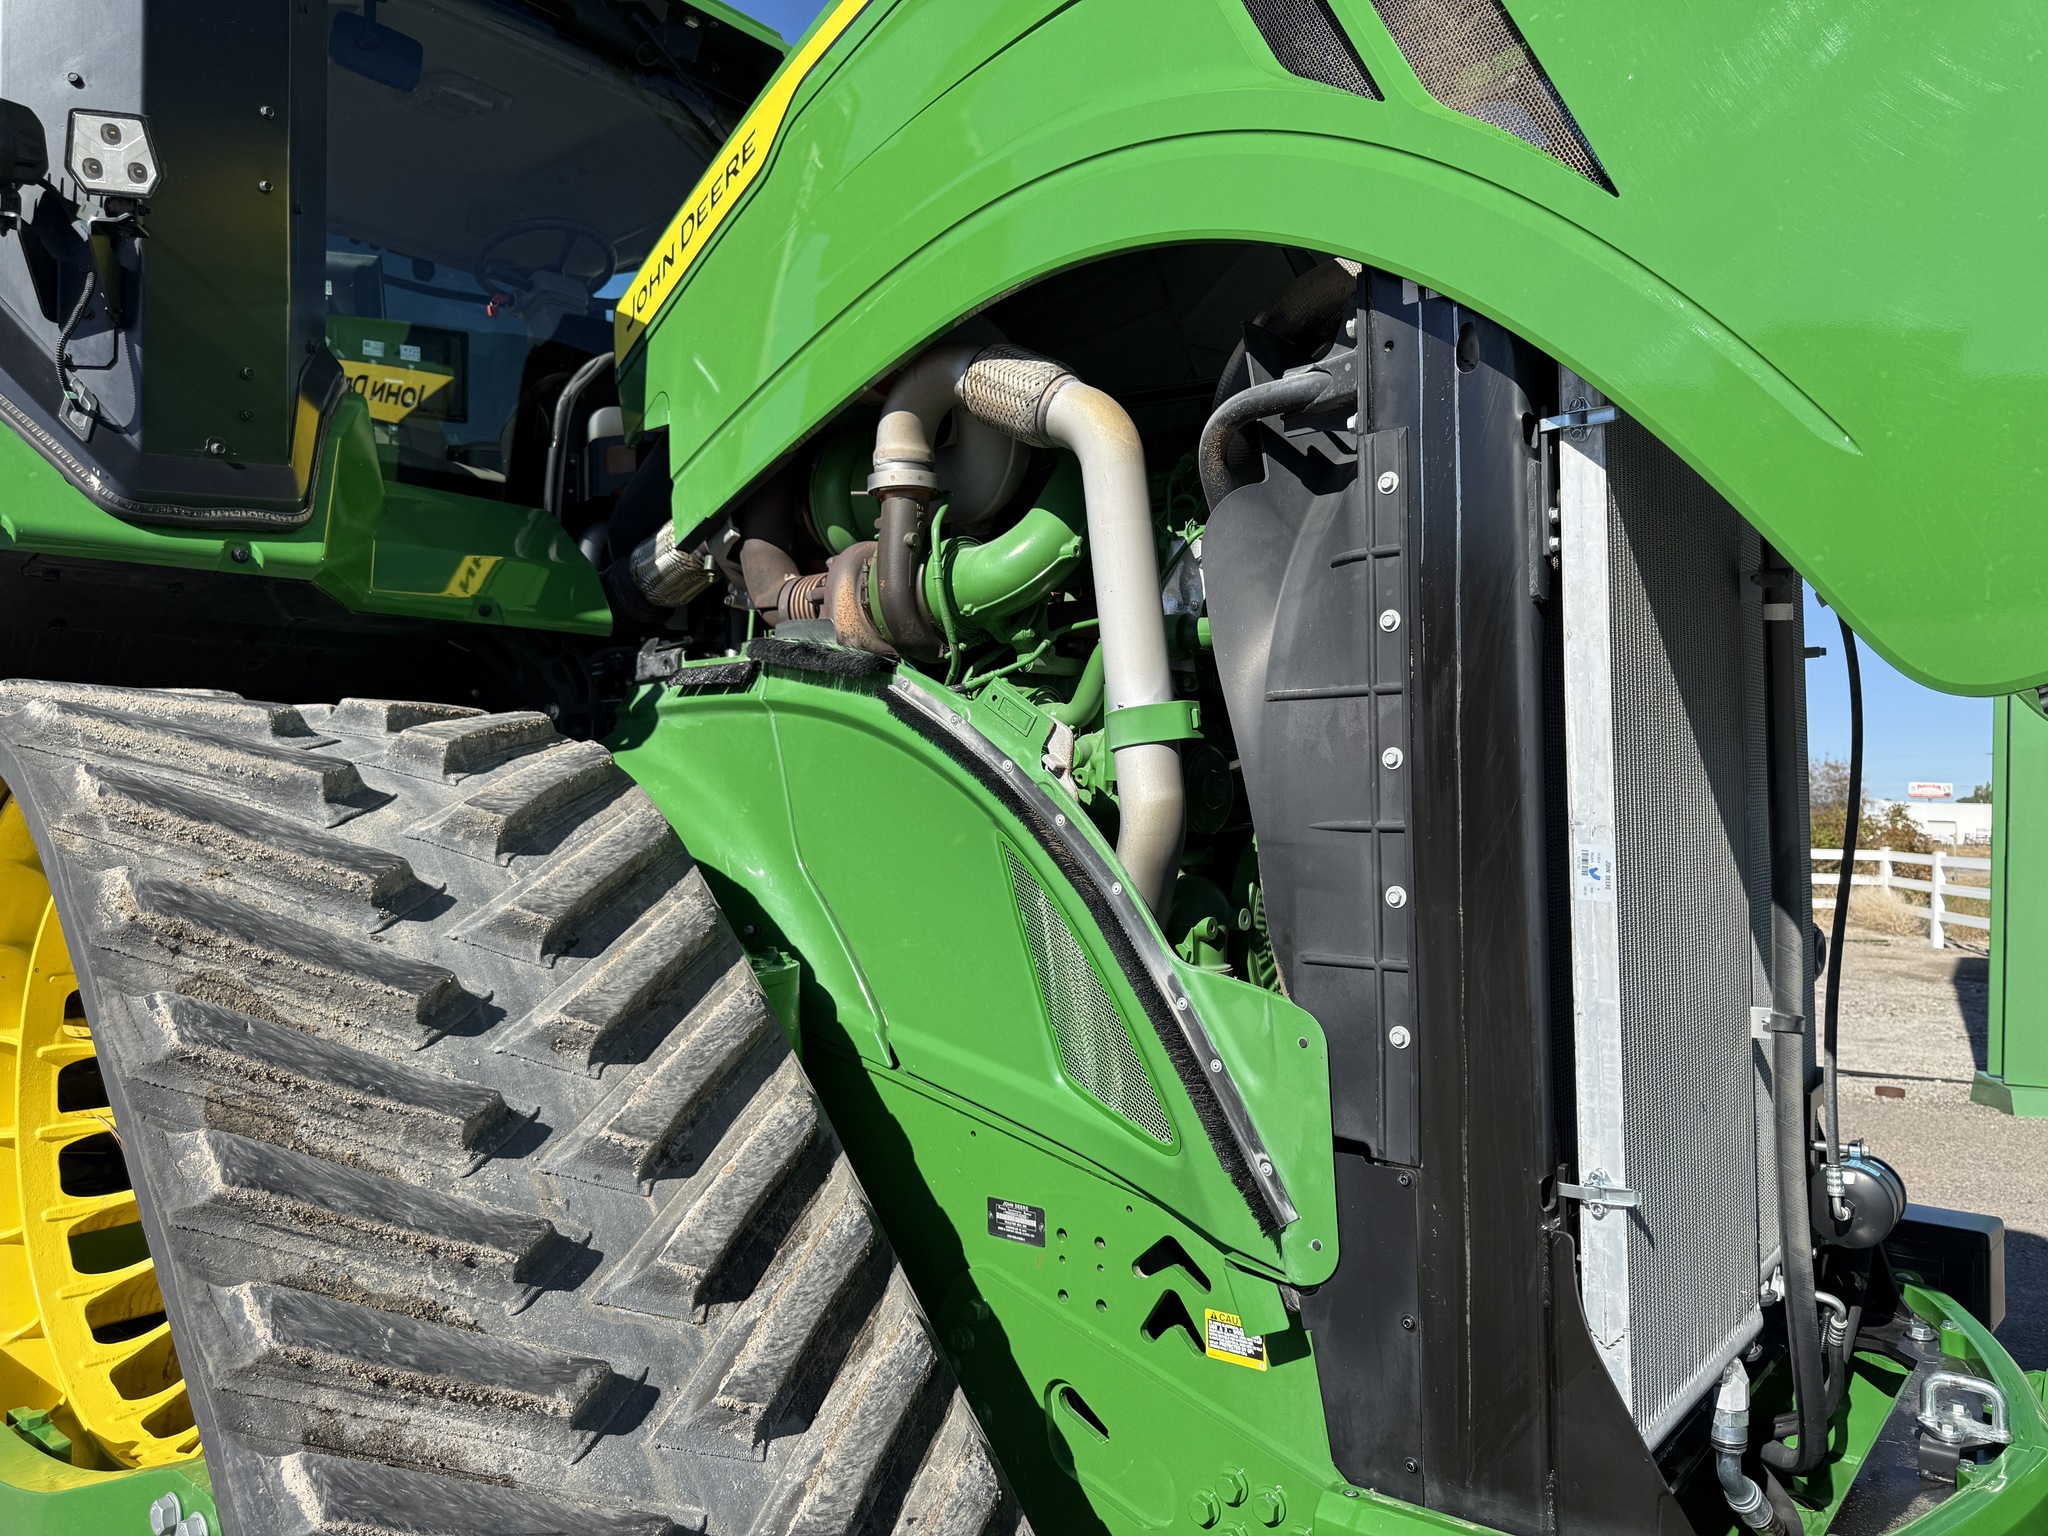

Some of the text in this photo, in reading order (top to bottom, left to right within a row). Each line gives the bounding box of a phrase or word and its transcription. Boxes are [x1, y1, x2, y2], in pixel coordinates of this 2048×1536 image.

[627, 129, 756, 332] JOHN DEERE
[1219, 1313, 1239, 1325] CAU
